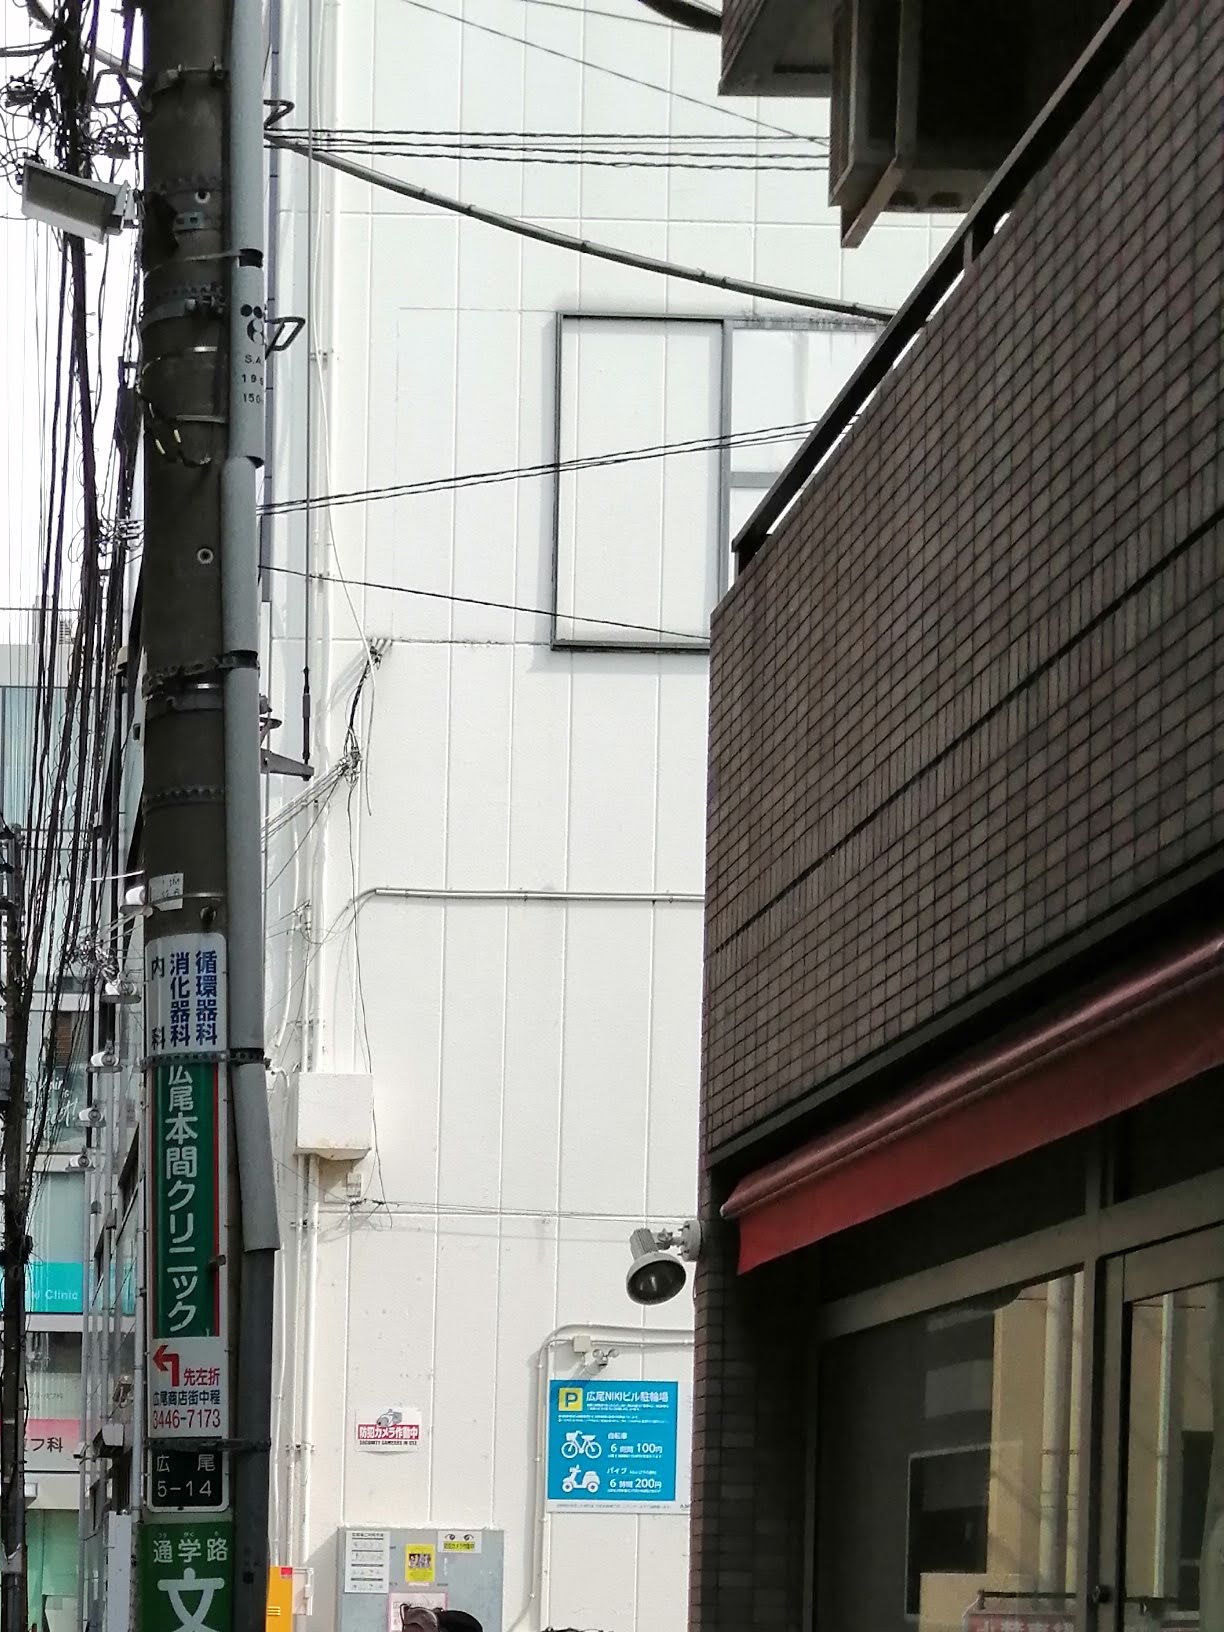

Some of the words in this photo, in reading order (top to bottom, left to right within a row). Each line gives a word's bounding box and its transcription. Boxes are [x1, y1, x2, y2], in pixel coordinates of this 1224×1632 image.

[151, 956, 166, 1051] 内科
[170, 951, 191, 1047] 消化器科
[195, 950, 217, 1046] 循環器科
[164, 1064, 199, 1333] 広尾本間クリニック
[44, 1289, 78, 1300] Clinic
[183, 1367, 221, 1387] 先左折
[153, 1389, 221, 1407] 広尾商店街中程
[152, 1409, 221, 1430] 3446-7173
[359, 1426, 418, 1439] 防犯カメラ作動中
[152, 1537, 228, 1564] 通学路
